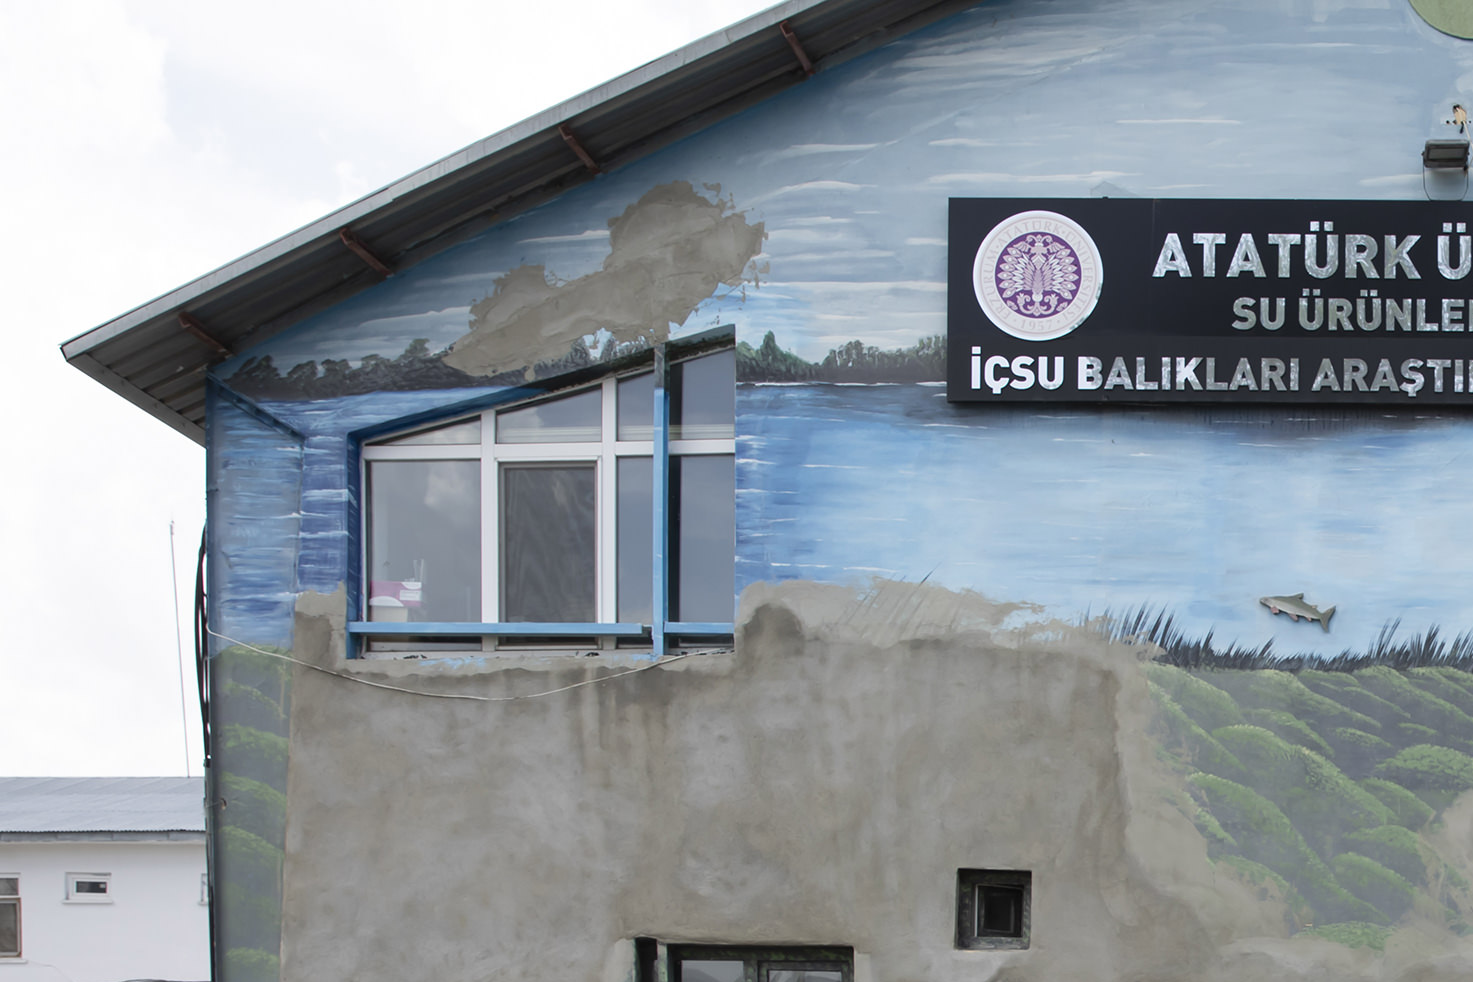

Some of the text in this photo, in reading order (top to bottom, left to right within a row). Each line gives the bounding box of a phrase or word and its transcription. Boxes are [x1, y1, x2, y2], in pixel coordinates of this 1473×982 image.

[1152, 220, 1422, 280] ATATÜRK
[1019, 318, 1053, 331] 1957
[1231, 296, 1286, 331] SU
[971, 345, 1065, 395] İÇSU
[1077, 356, 1300, 392] BALIKLARI
